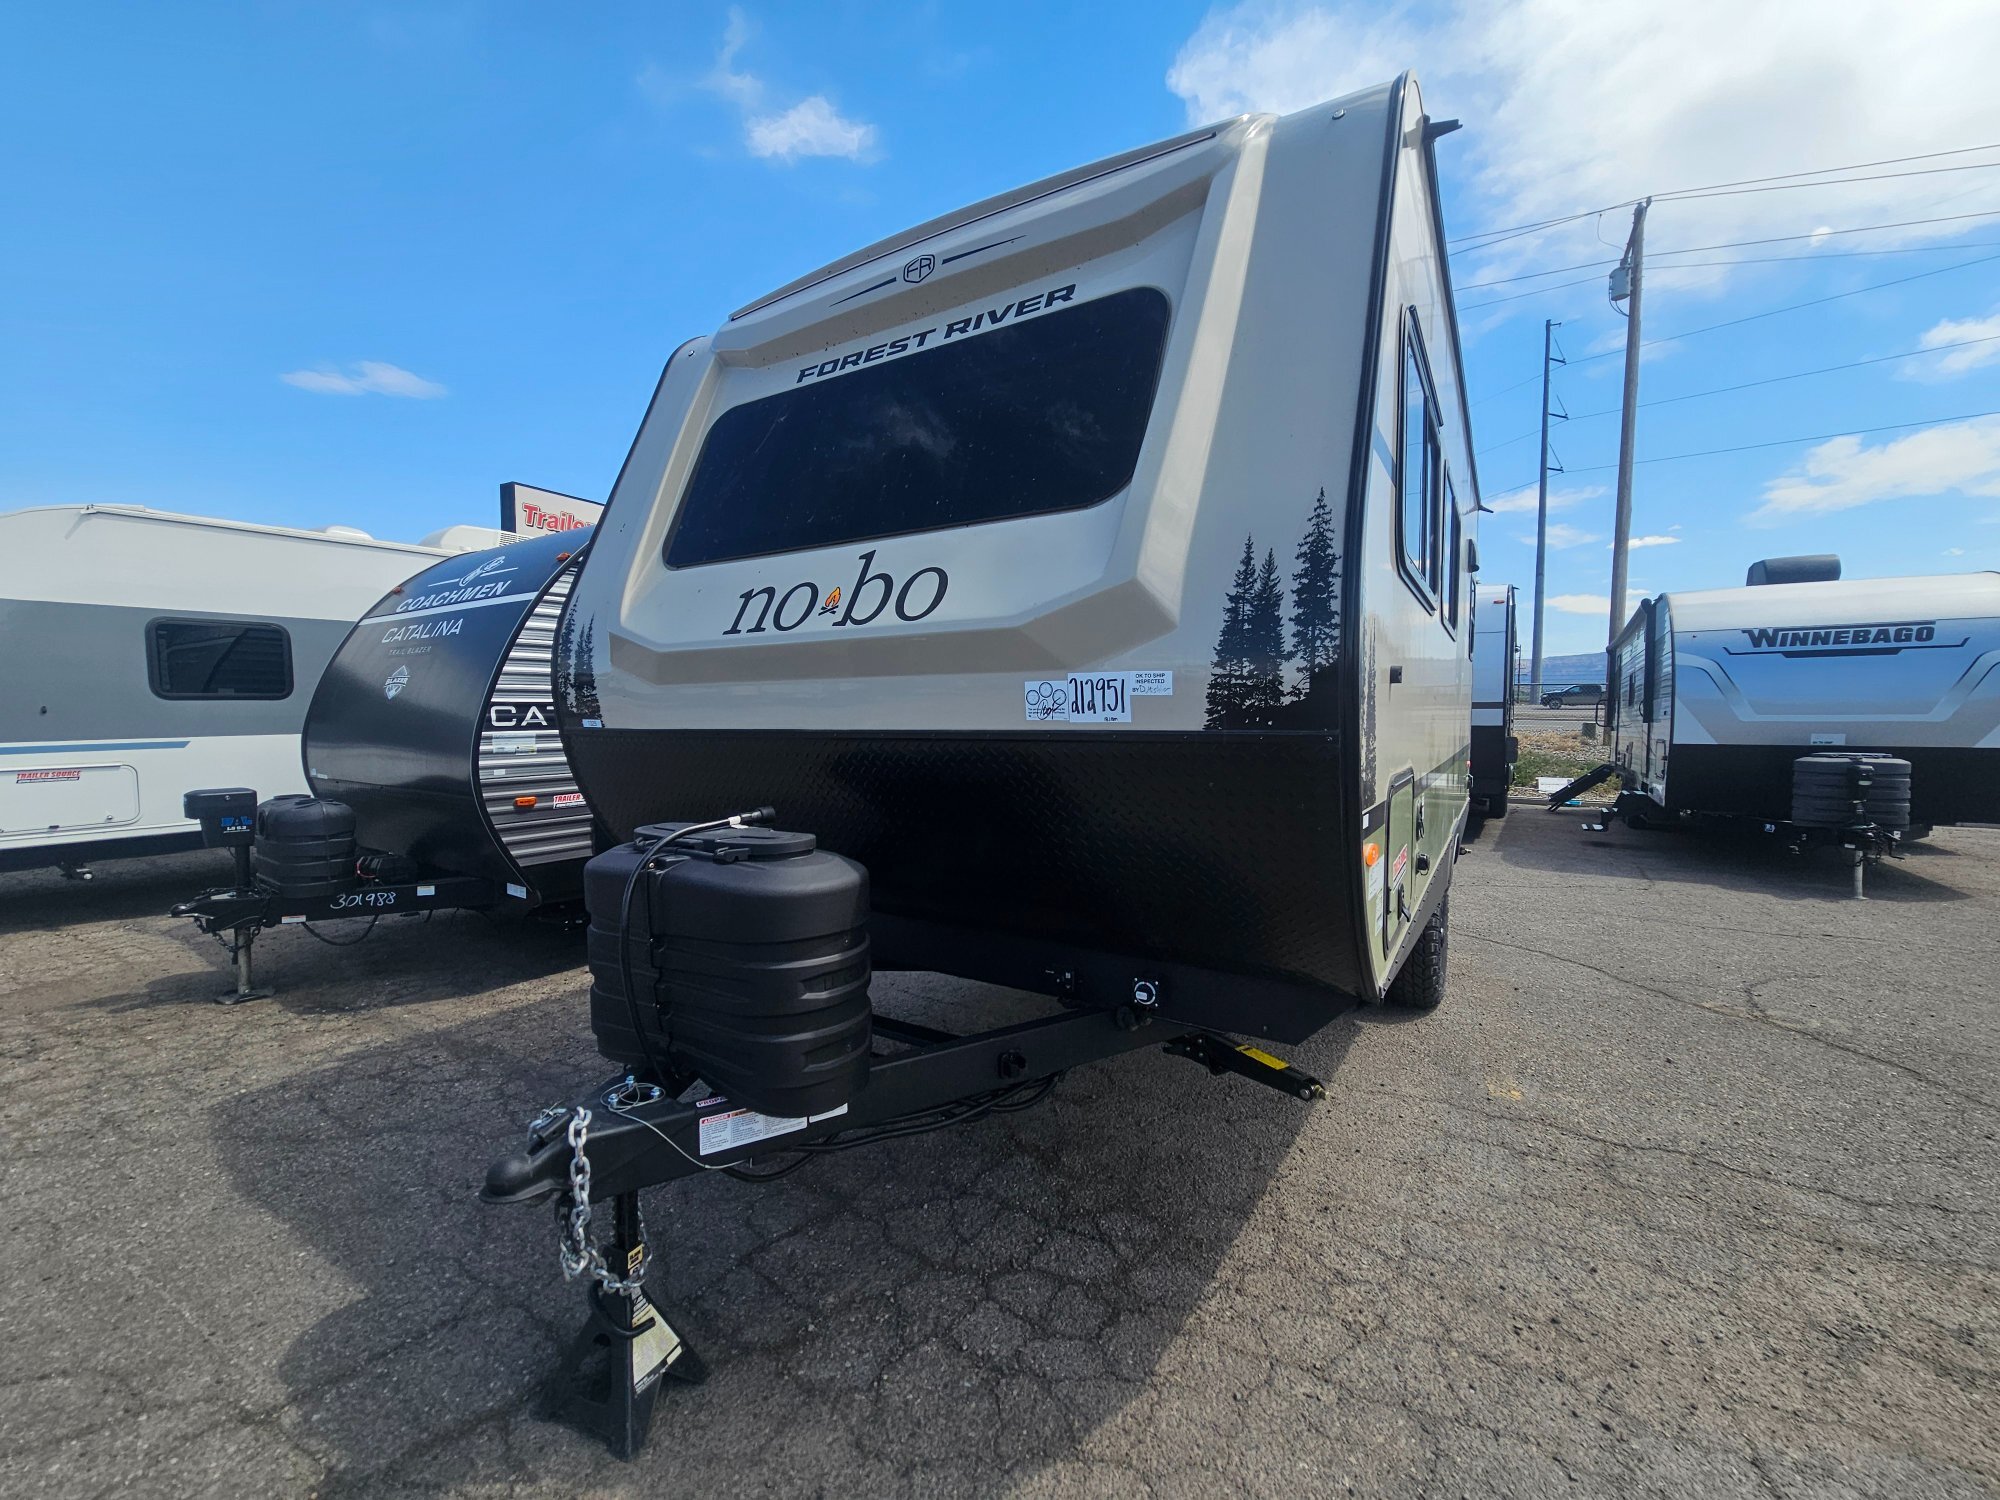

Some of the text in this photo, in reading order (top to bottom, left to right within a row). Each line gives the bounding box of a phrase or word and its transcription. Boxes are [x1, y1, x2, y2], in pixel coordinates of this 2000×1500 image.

[796, 283, 1077, 384] FOREST RIVER
[396, 580, 512, 613] COACHMEN
[381, 618, 464, 644] CATALINA
[1741, 626, 1935, 649] WINNEBAGO
[385, 676, 409, 686] BLAZER
[1068, 677, 1126, 715] 212951
[555, 793, 581, 803] TRAILER
[330, 891, 397, 910] 301988
